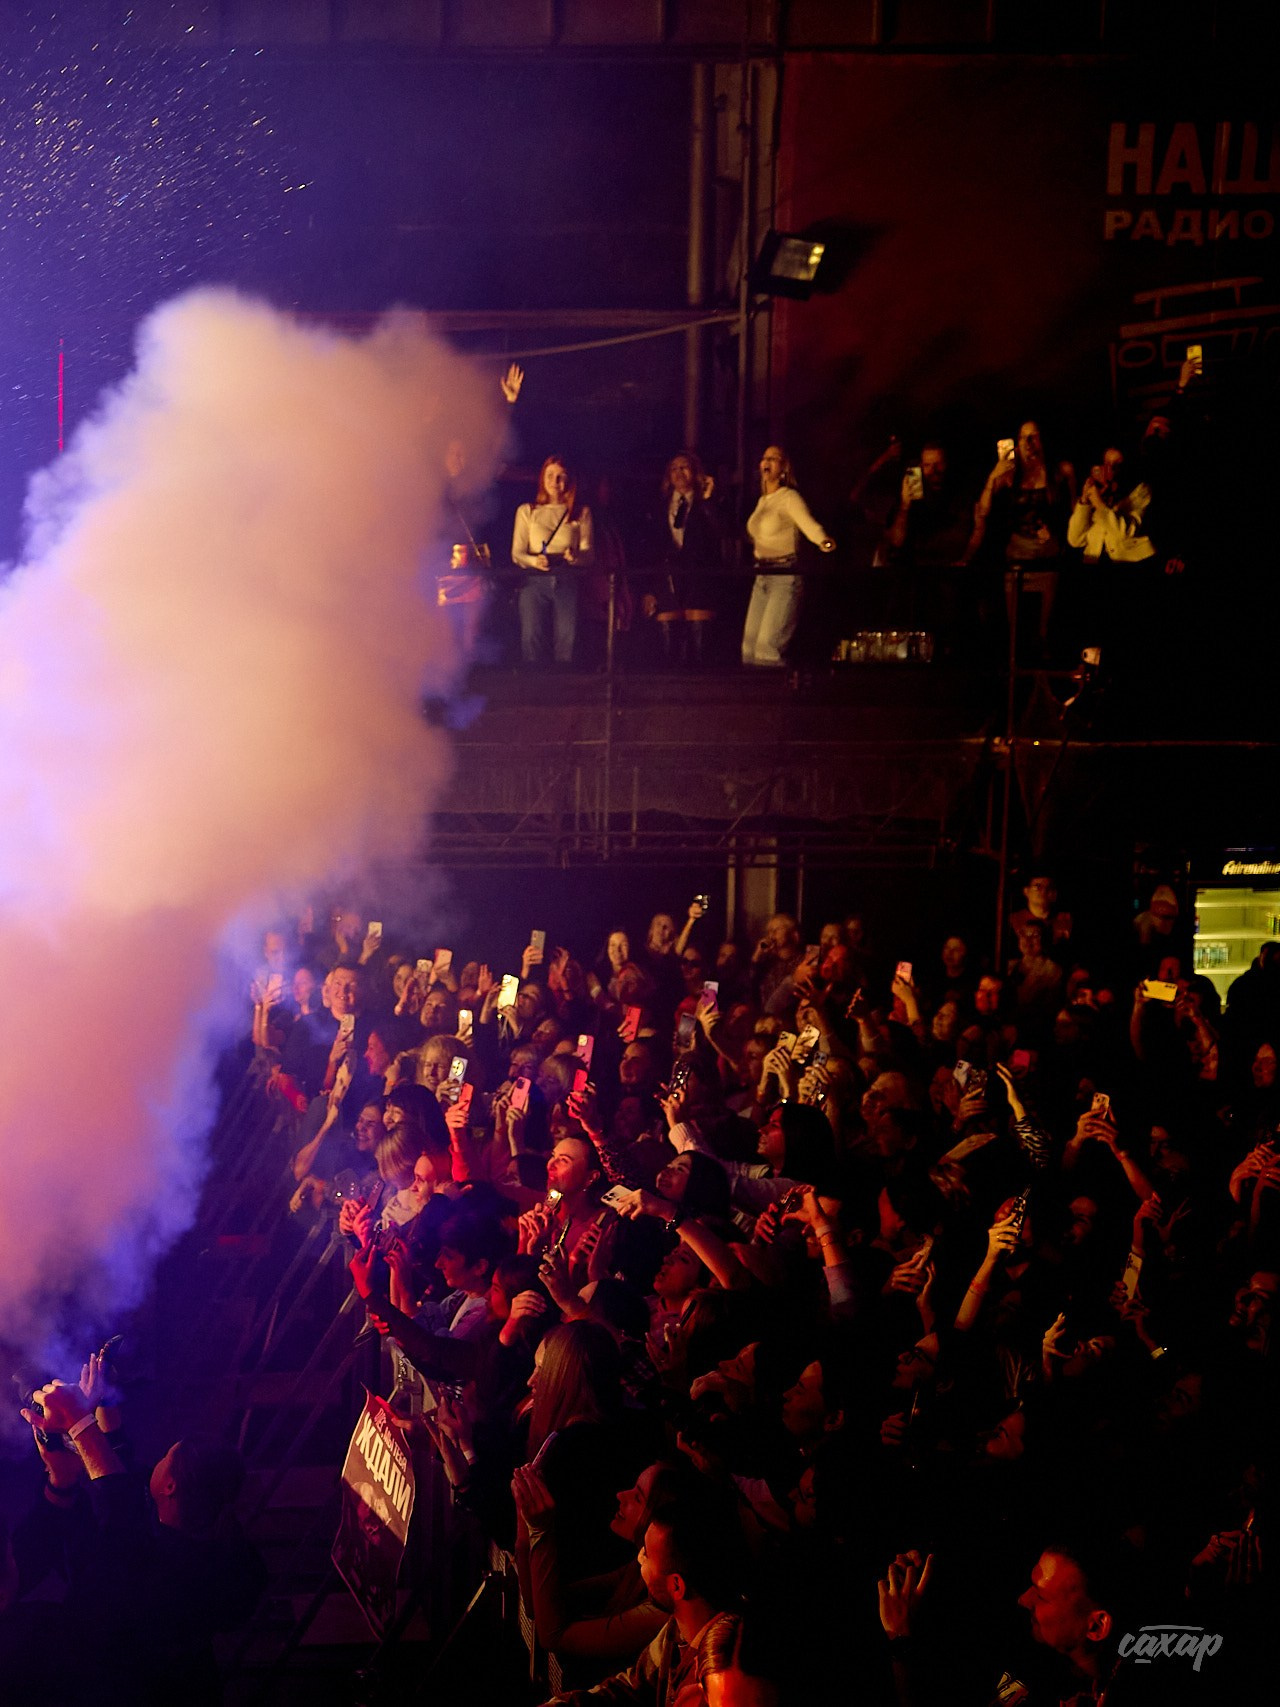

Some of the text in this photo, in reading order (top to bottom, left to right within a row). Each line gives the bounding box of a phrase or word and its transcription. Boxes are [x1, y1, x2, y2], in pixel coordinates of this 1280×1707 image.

[1103, 209, 1275, 247] РАДИО
[355, 1411, 412, 1521] ЖДАЛИ
[393, 1441, 408, 1473] ТЕБЯ
